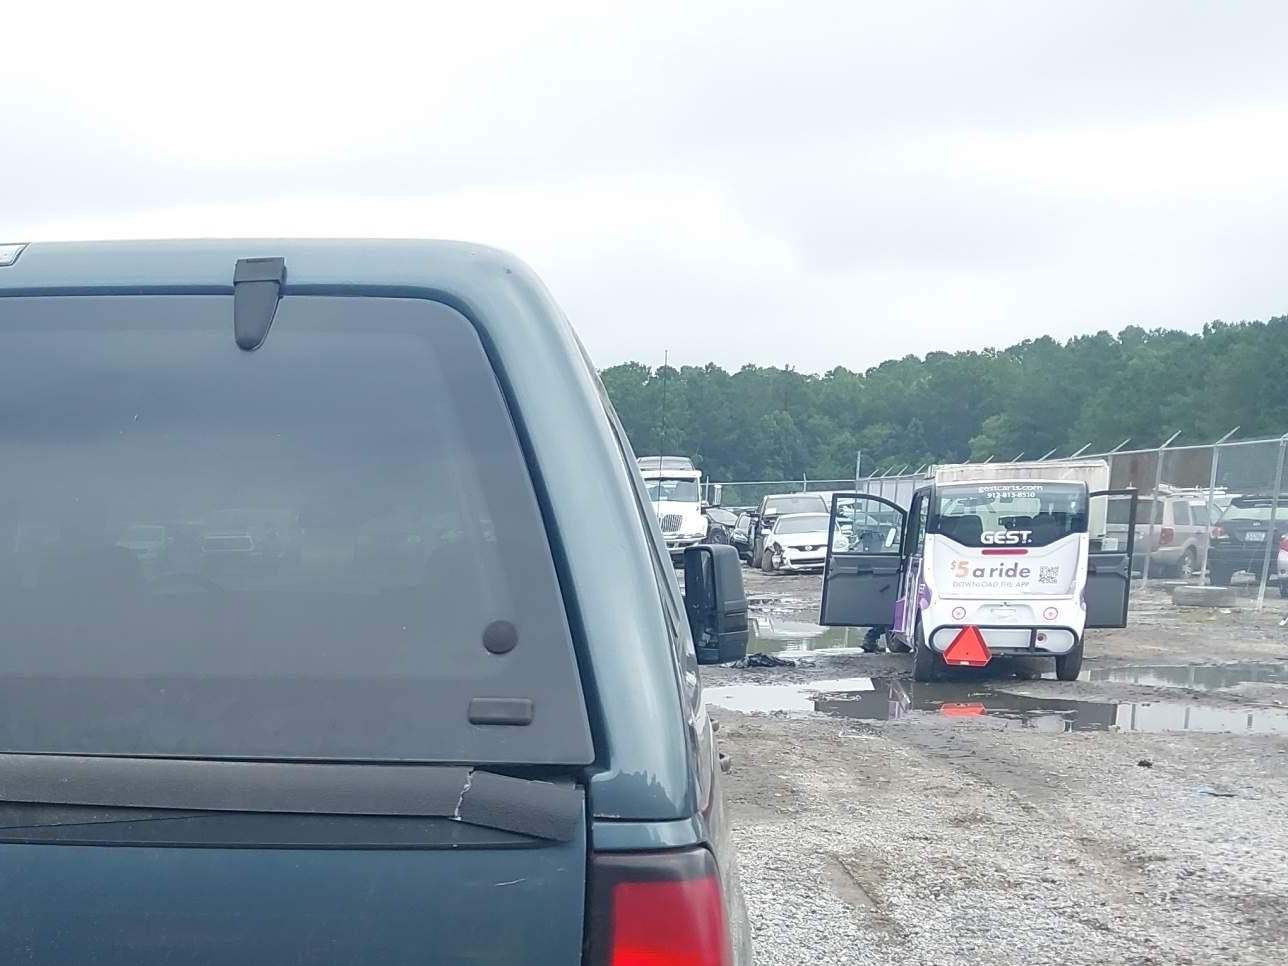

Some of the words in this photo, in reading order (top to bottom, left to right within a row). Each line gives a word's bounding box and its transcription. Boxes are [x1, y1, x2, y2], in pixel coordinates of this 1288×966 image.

[950, 560, 969, 578] $5
[972, 567, 985, 578] a
[989, 562, 1031, 578] ride
